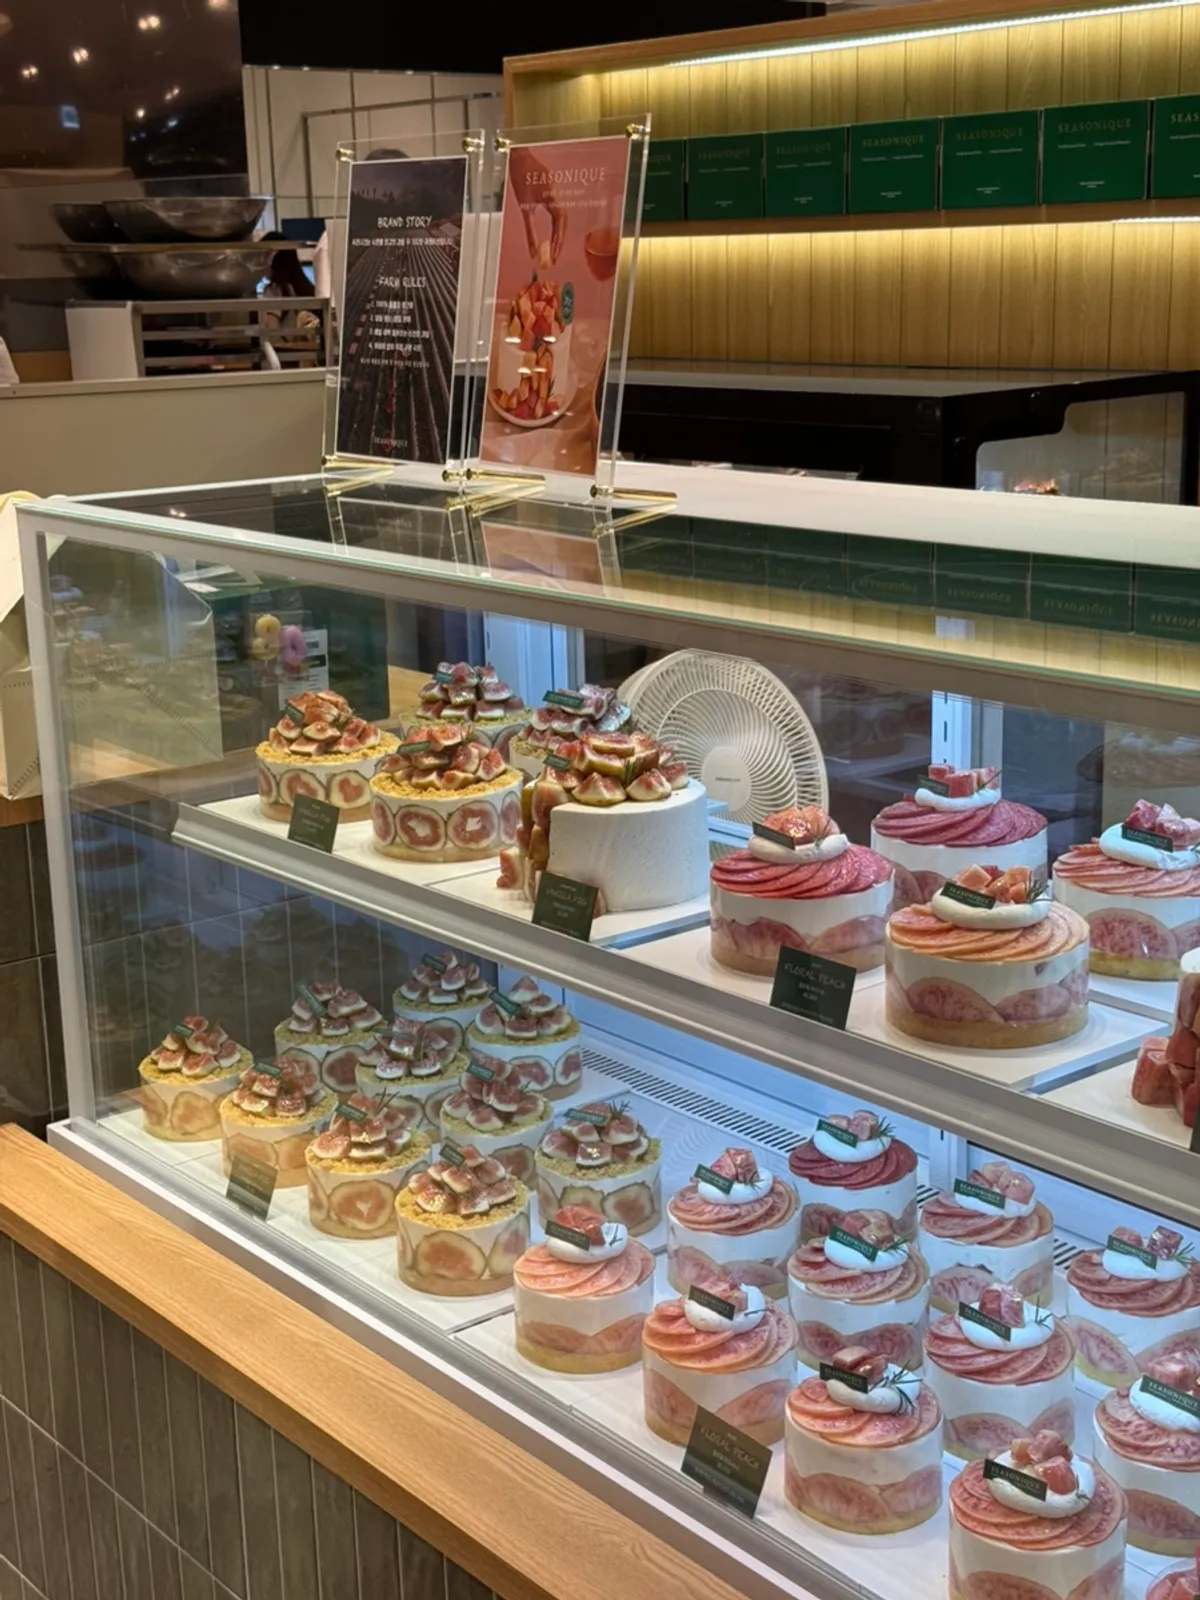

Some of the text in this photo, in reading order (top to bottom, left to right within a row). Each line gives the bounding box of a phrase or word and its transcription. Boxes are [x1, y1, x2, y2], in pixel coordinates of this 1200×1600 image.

[1057, 118, 1132, 133] SEASONIQUE
[861, 134, 925, 148] SEASONIQUE
[956, 126, 1023, 142] SEASONIQUE
[525, 167, 606, 186] SEASONIQUE
[378, 215, 432, 228] BRAND STORY
[1149, 1380, 1198, 1408] SEASONIQUE
